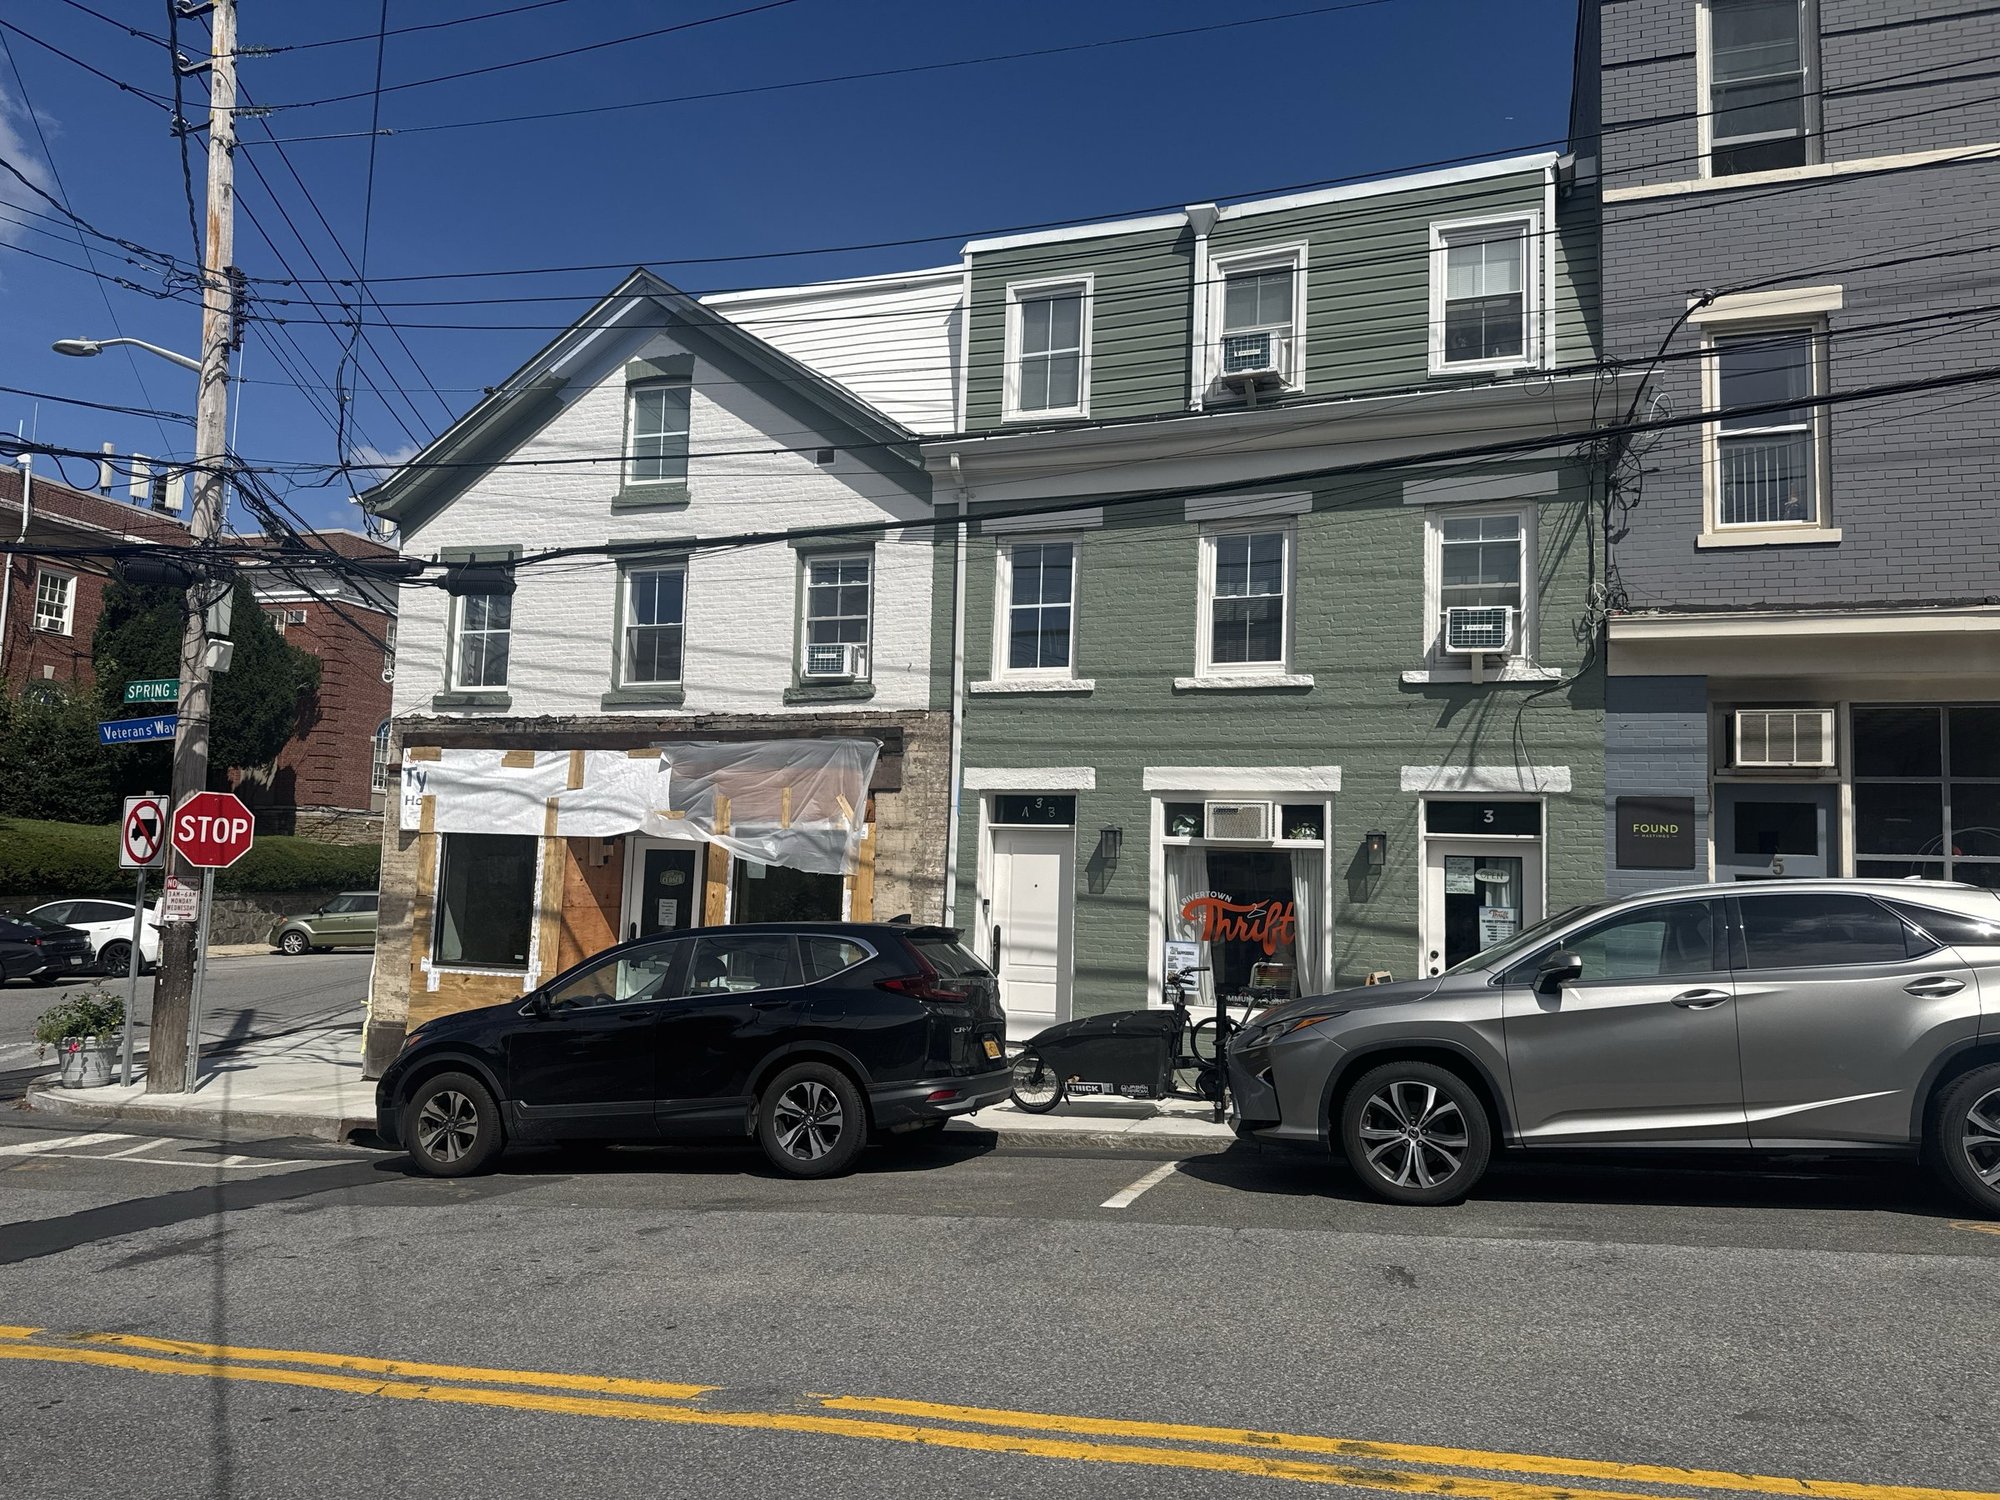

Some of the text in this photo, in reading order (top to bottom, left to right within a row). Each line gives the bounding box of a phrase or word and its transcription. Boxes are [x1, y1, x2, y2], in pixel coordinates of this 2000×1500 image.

[128, 684, 170, 699] SPRING
[103, 720, 176, 740] Veterans' Way
[403, 766, 427, 793] Ty
[1035, 797, 1044, 809] 3
[1483, 809, 1494, 823] 3
[178, 815, 249, 845] STOP
[1633, 823, 1679, 834] FOUND
[1772, 857, 1784, 875] 5
[1480, 870, 1503, 880] OPEN
[167, 879, 177, 888] NO
[1182, 890, 1233, 905] RIVERTOWN
[1183, 899, 1296, 956] Thrift
